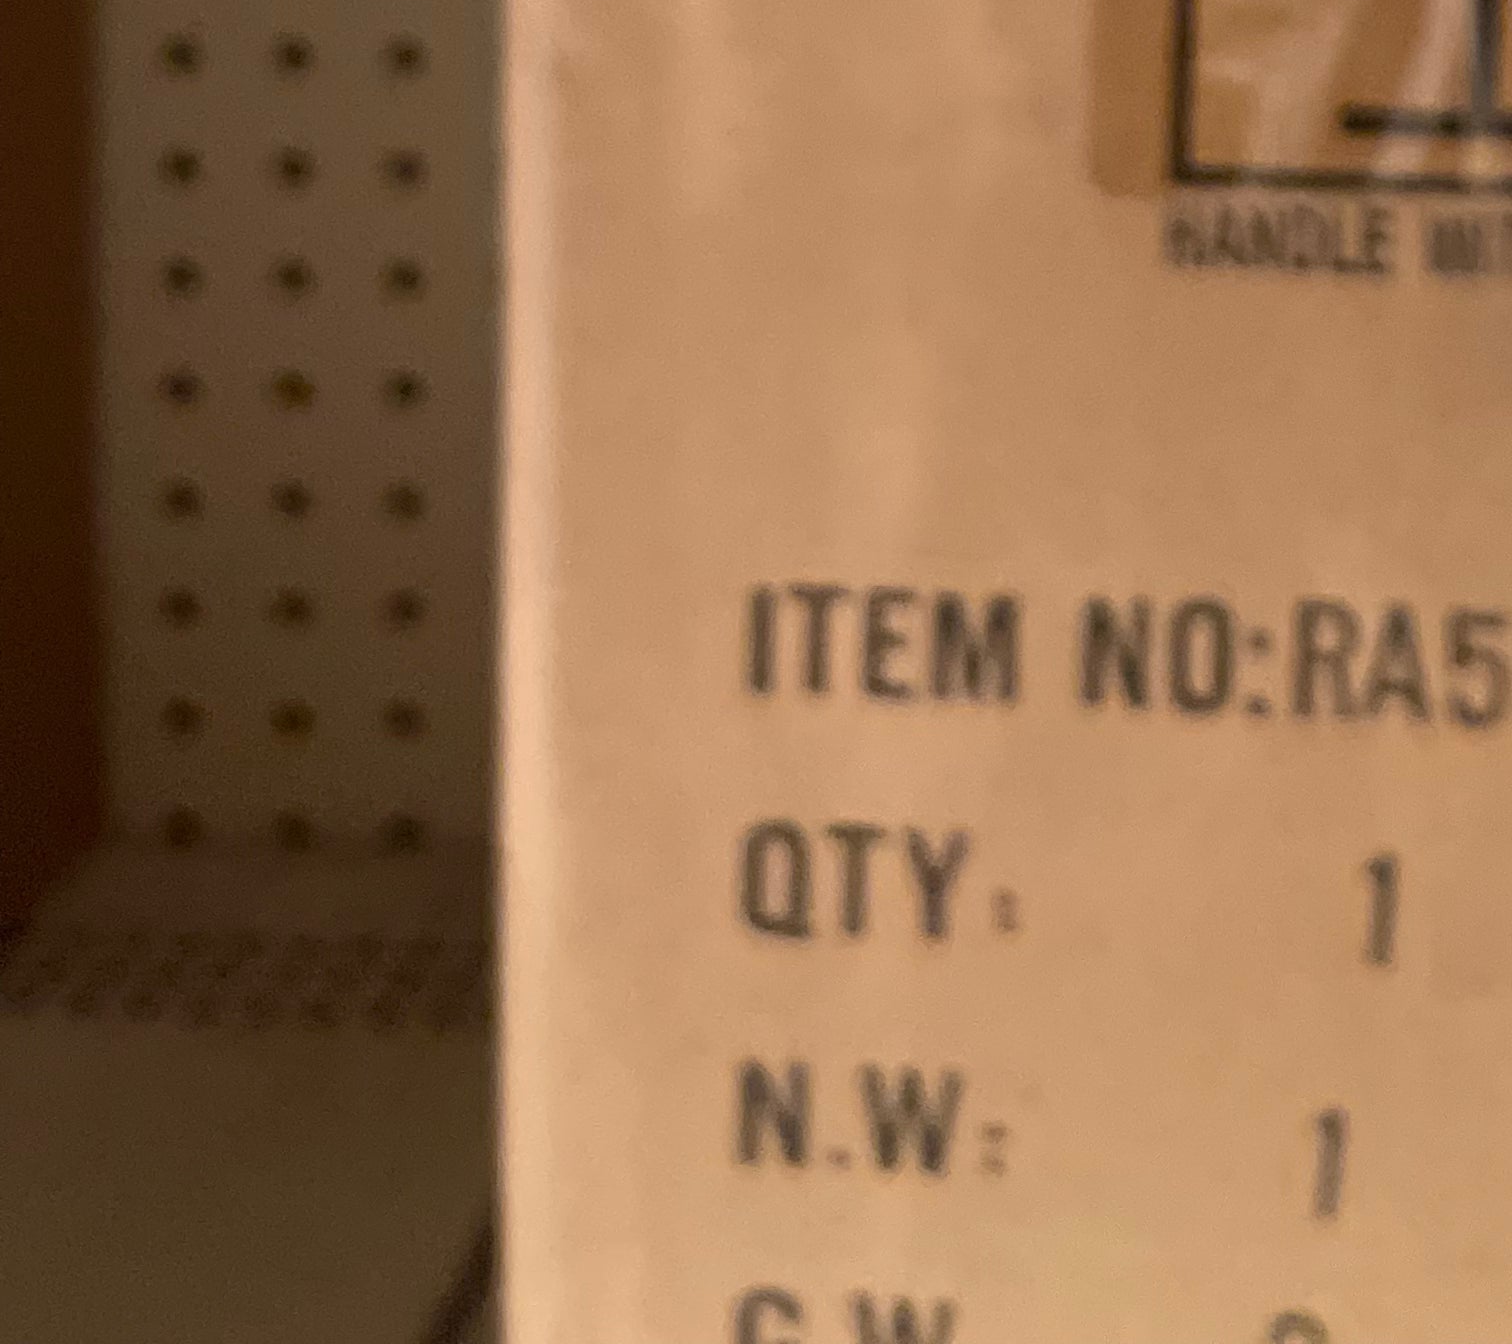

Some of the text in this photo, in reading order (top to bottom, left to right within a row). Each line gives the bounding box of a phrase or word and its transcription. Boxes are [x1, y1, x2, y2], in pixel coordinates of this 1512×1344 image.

[745, 583, 1022, 703] ITEM
[739, 818, 1020, 943] QTY:
[1364, 850, 1400, 970] 1
[734, 1056, 1010, 1178] N.W:
[1312, 1106, 1351, 1222] 1
